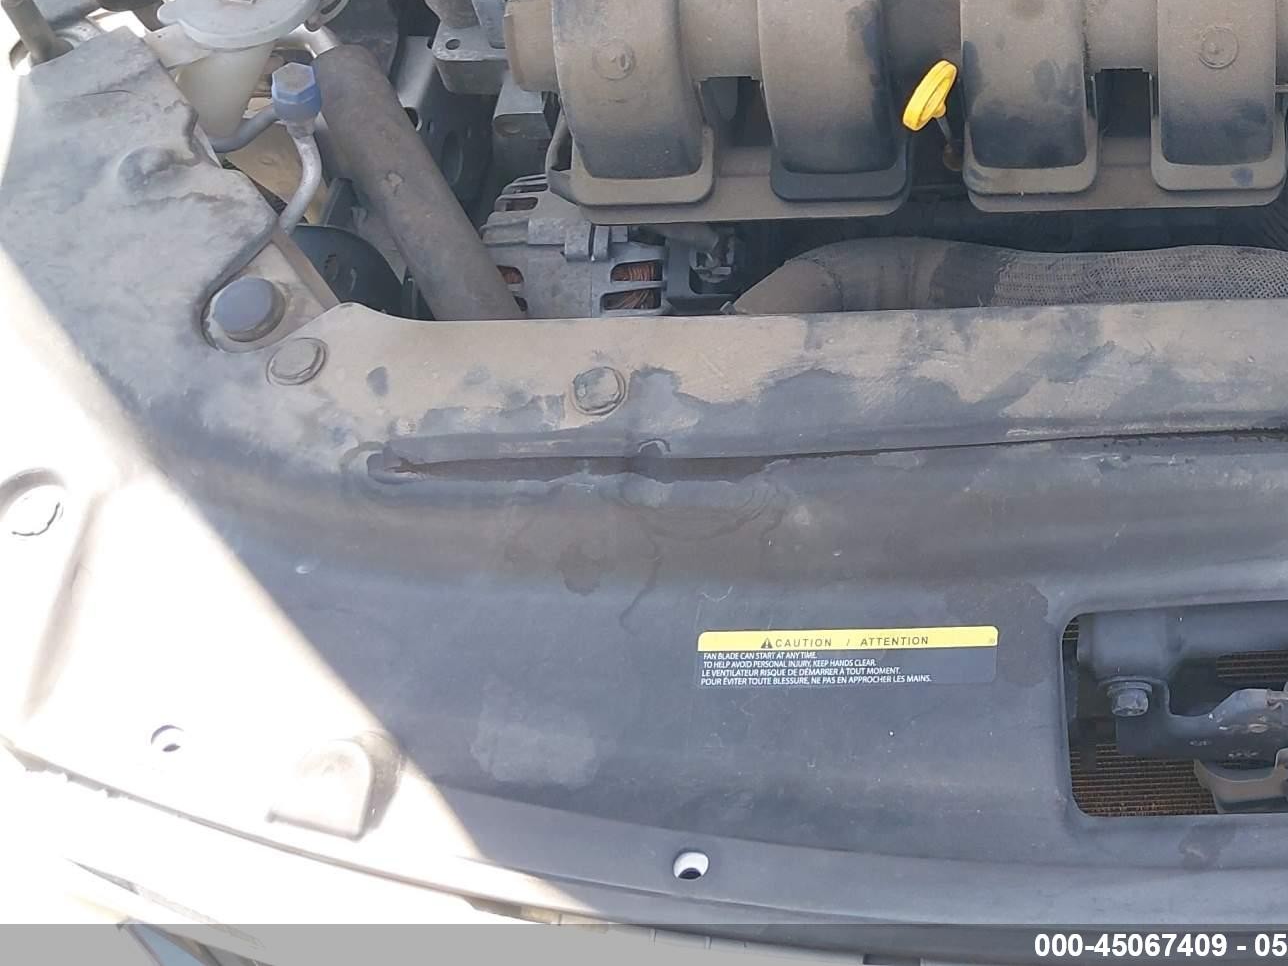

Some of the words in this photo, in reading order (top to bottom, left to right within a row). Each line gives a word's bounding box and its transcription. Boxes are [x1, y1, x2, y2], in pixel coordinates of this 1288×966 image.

[775, 638, 832, 648] CAUTION
[860, 636, 929, 646] ATTENTION
[703, 652, 717, 660] FAN
[717, 652, 739, 660] BLADE
[740, 652, 755, 660] CAN
[776, 651, 785, 659] AT
[786, 651, 800, 659] ANY
[714, 660, 731, 668] HELP
[731, 660, 752, 668] AVOID
[753, 660, 787, 668] PERSONAL
[812, 659, 829, 667] KEEP
[830, 659, 853, 667] HANDS
[854, 658, 876, 666] CLEAR.
[702, 669, 711, 677] LE
[711, 669, 759, 677] VENTILATEUR
[760, 668, 786, 677] RISQUE
[787, 668, 798, 676] DE
[799, 667, 838, 676] DÉMARRER
[845, 667, 866, 675] TOUT
[866, 666, 901, 675] MOMENT.
[701, 677, 722, 685] POUR
[748, 677, 772, 685] TOUTE
[811, 676, 821, 684] NE
[822, 676, 835, 684] PAS
[837, 676, 847, 684] EN
[848, 675, 891, 684] APPROCHER
[893, 675, 905, 683] LES
[907, 674, 933, 683] MAINS.
